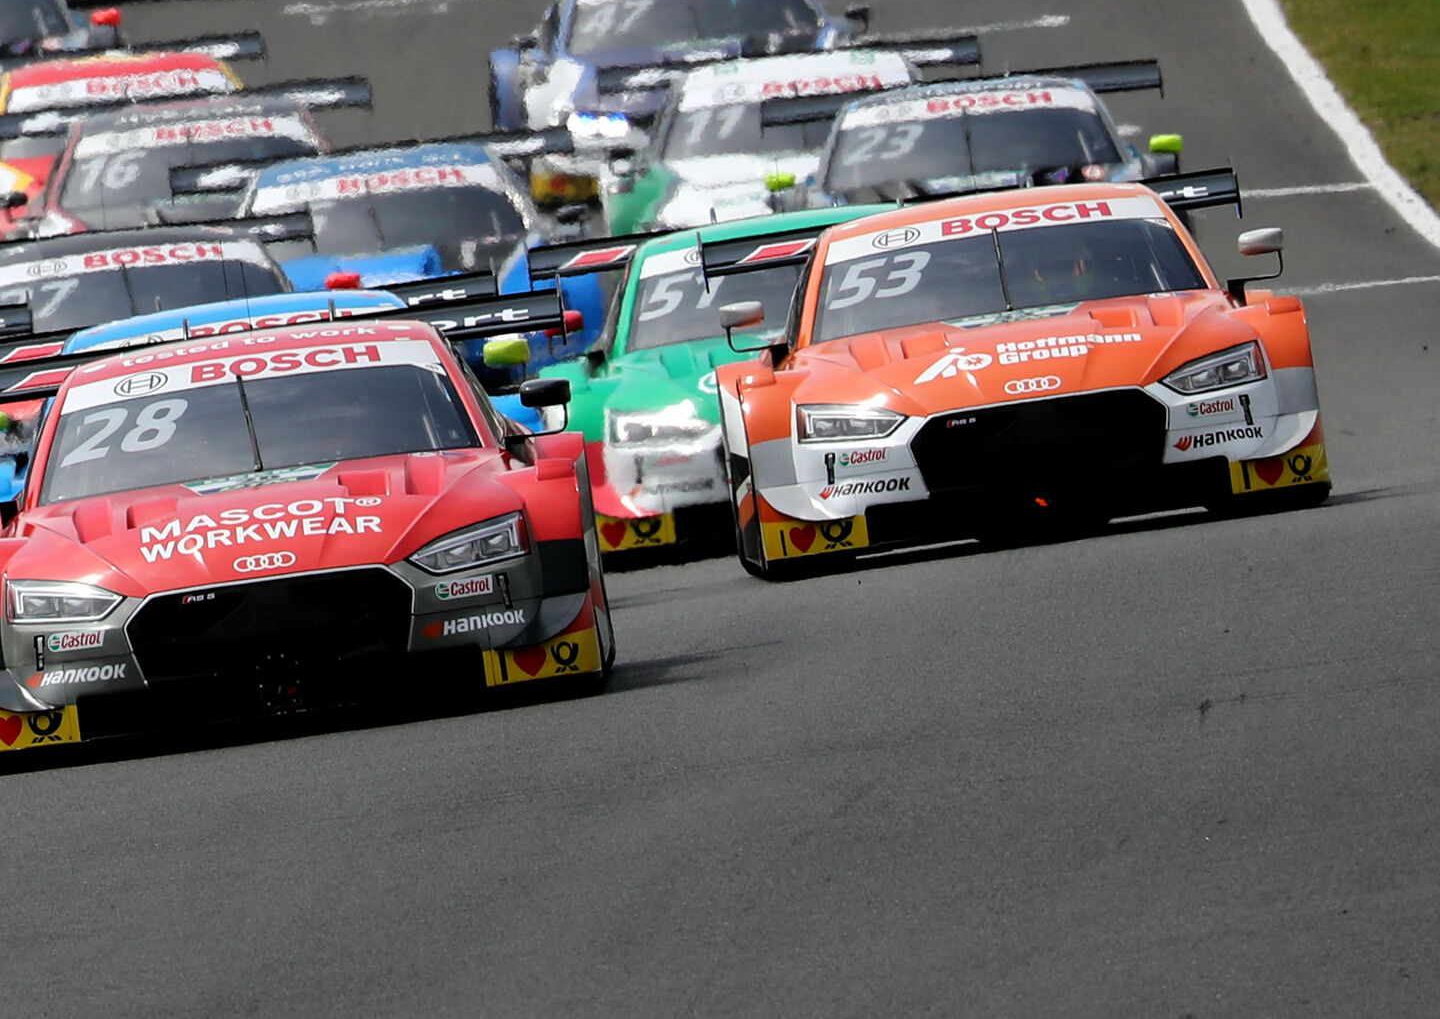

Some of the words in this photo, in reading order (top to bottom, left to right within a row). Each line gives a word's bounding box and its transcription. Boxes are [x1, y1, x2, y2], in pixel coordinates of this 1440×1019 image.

[928, 91, 1052, 114] BOSCH
[156, 119, 275, 142] BOSCH
[843, 125, 925, 166] 23
[81, 152, 149, 192] 16
[941, 202, 1113, 237] BOSCH
[83, 244, 222, 270] BOSCH
[828, 251, 931, 310] 53
[639, 271, 725, 322] 51
[122, 341, 231, 367] tested
[244, 333, 273, 347] to
[290, 324, 377, 340] work
[996, 332, 1143, 354] Hoffmann
[998, 343, 1089, 366] Group
[190, 345, 382, 384] BOSCH
[1200, 398, 1235, 416] Castrol
[60, 398, 189, 468] 28
[850, 447, 887, 466] Castrol
[140, 516, 383, 565] WORKWEAR
[450, 577, 491, 597] Castrol
[61, 631, 101, 649] Castrol
